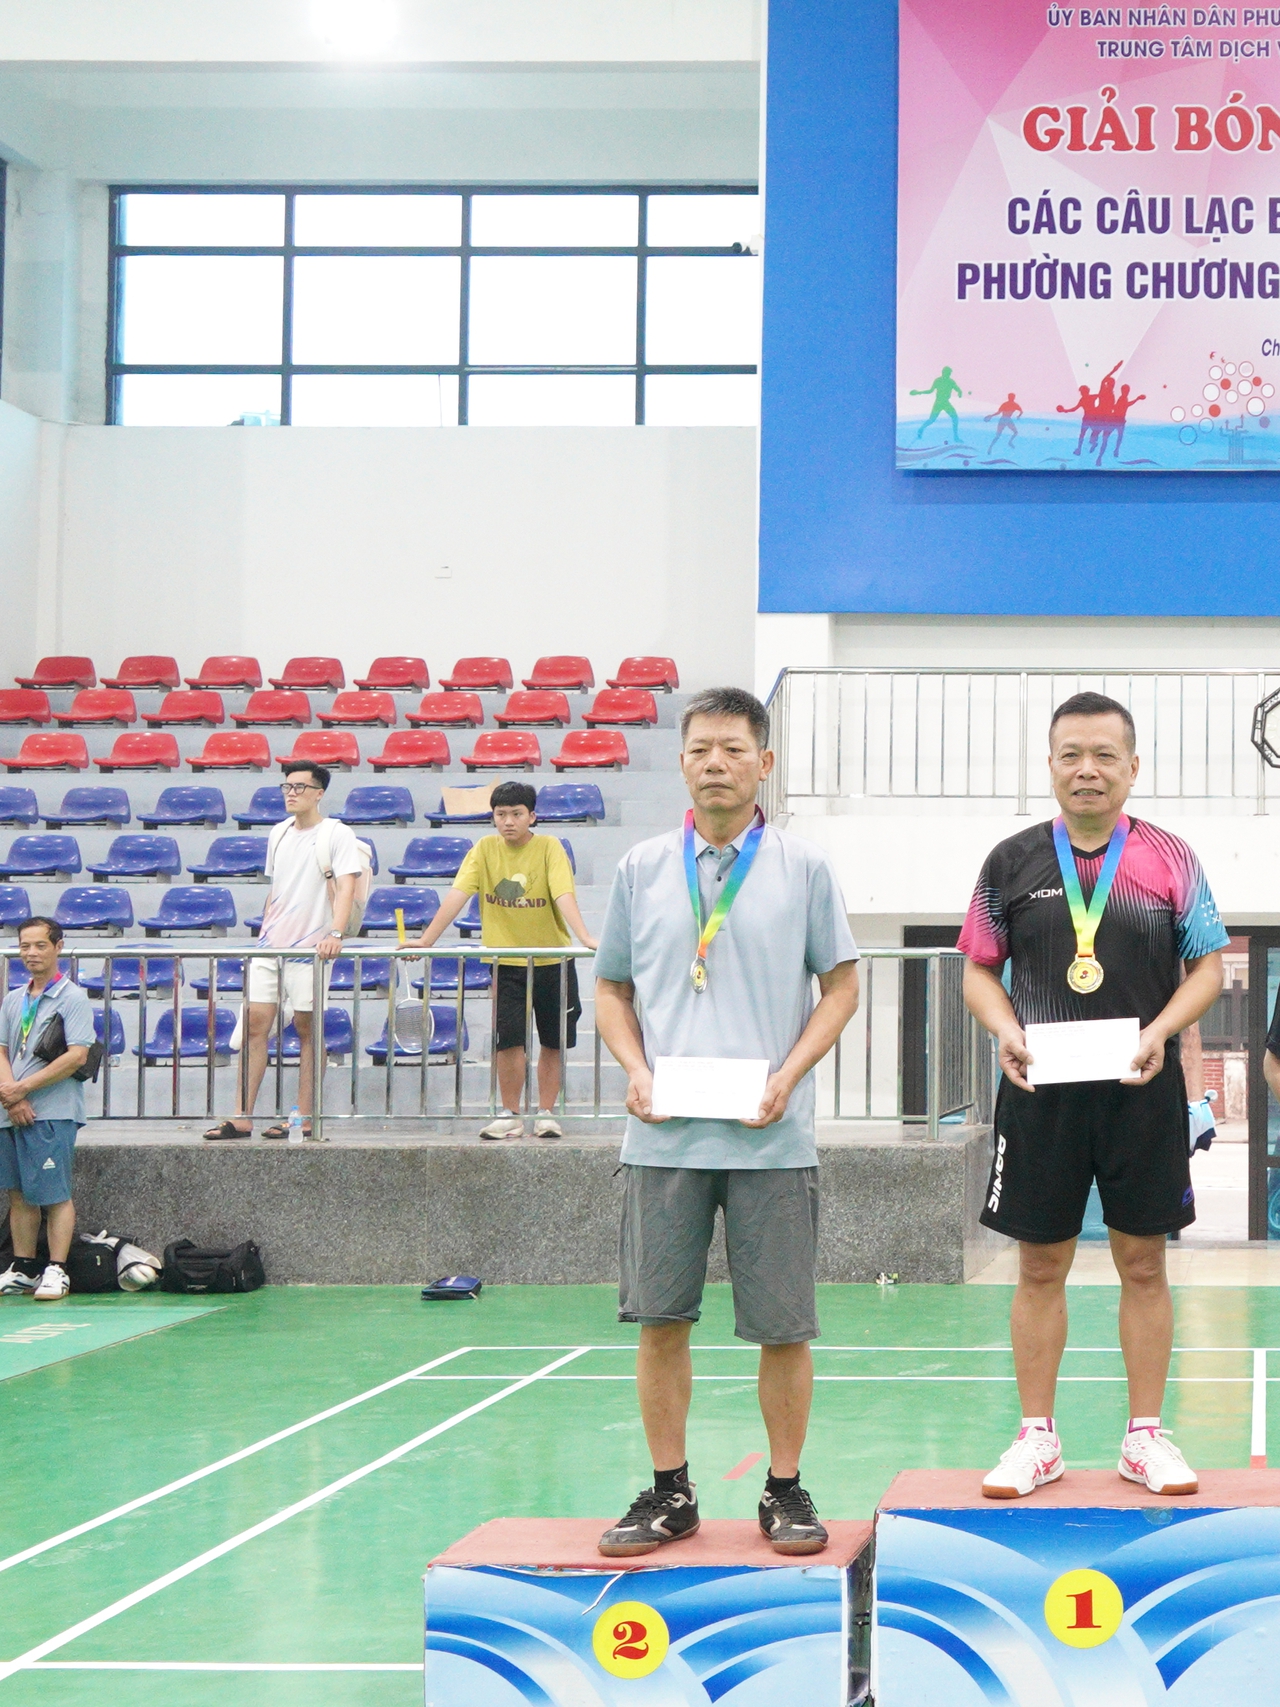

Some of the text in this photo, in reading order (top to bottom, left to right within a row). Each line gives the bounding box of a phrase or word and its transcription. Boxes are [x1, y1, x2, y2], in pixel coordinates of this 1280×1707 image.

[1048, 3, 1073, 26] ỦY
[1080, 9, 1121, 26] BAN
[1128, 8, 1186, 26] NHÂN
[1193, 8, 1235, 26] DÂN
[1097, 41, 1164, 58] TRUNG
[1171, 37, 1212, 57] TÂM
[1220, 41, 1269, 62] DỊCH
[1022, 86, 1156, 152] GIẢI
[1008, 189, 1082, 235] CÁC
[1096, 189, 1170, 235] CÂU
[1185, 197, 1254, 243] LẠC
[957, 253, 1111, 300] PHƯỜNG
[1126, 257, 1280, 300] CHƯƠNG
[987, 1133, 1008, 1213] DONIC
[1066, 1589, 1103, 1629] 1
[612, 1620, 650, 1660] 2
